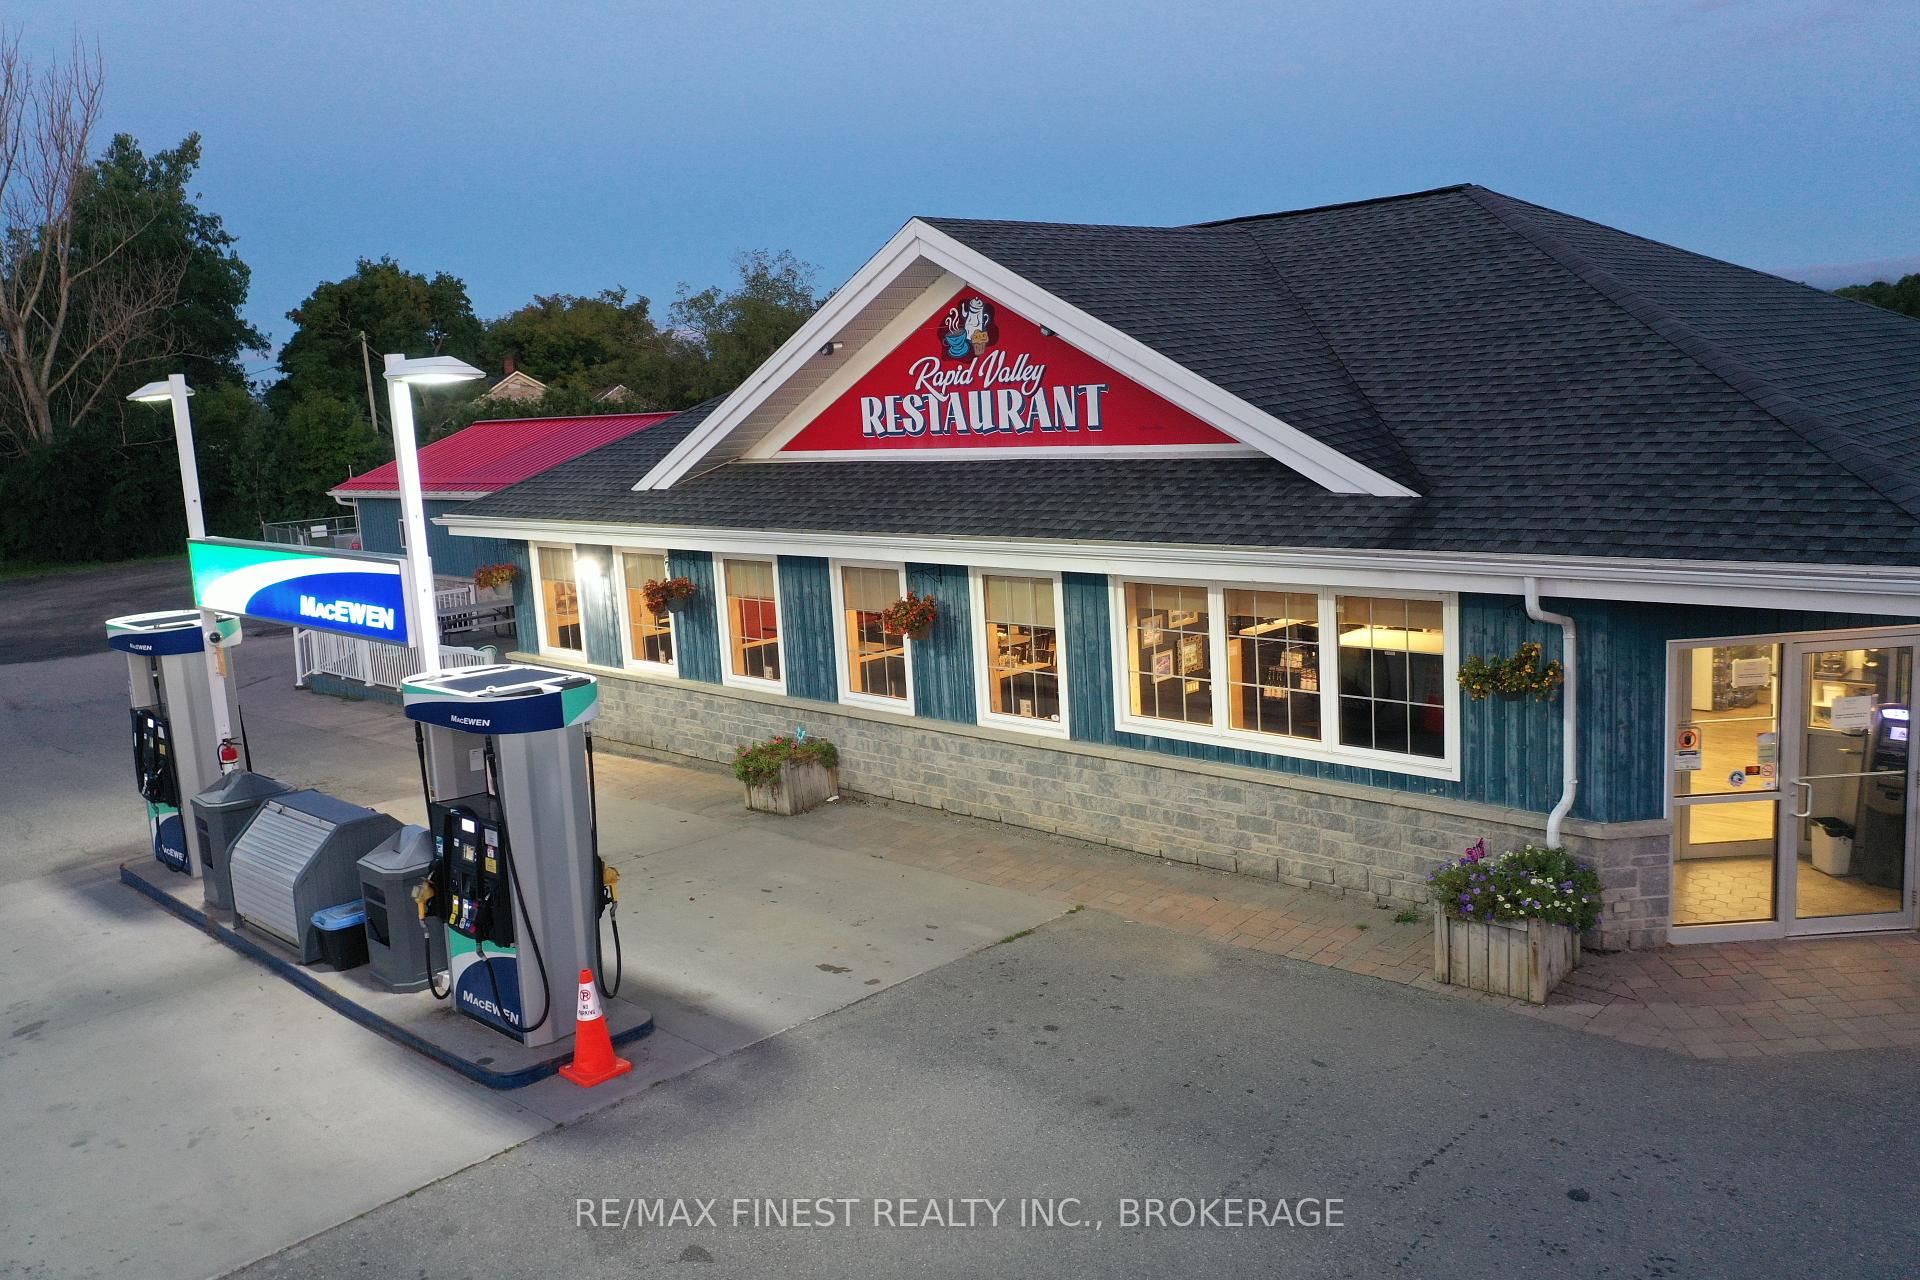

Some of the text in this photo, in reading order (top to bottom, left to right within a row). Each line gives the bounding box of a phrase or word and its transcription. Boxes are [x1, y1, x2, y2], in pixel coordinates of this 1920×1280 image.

[908, 349, 1046, 402] Rapid Valley
[860, 383, 1109, 438] RESTAURANT
